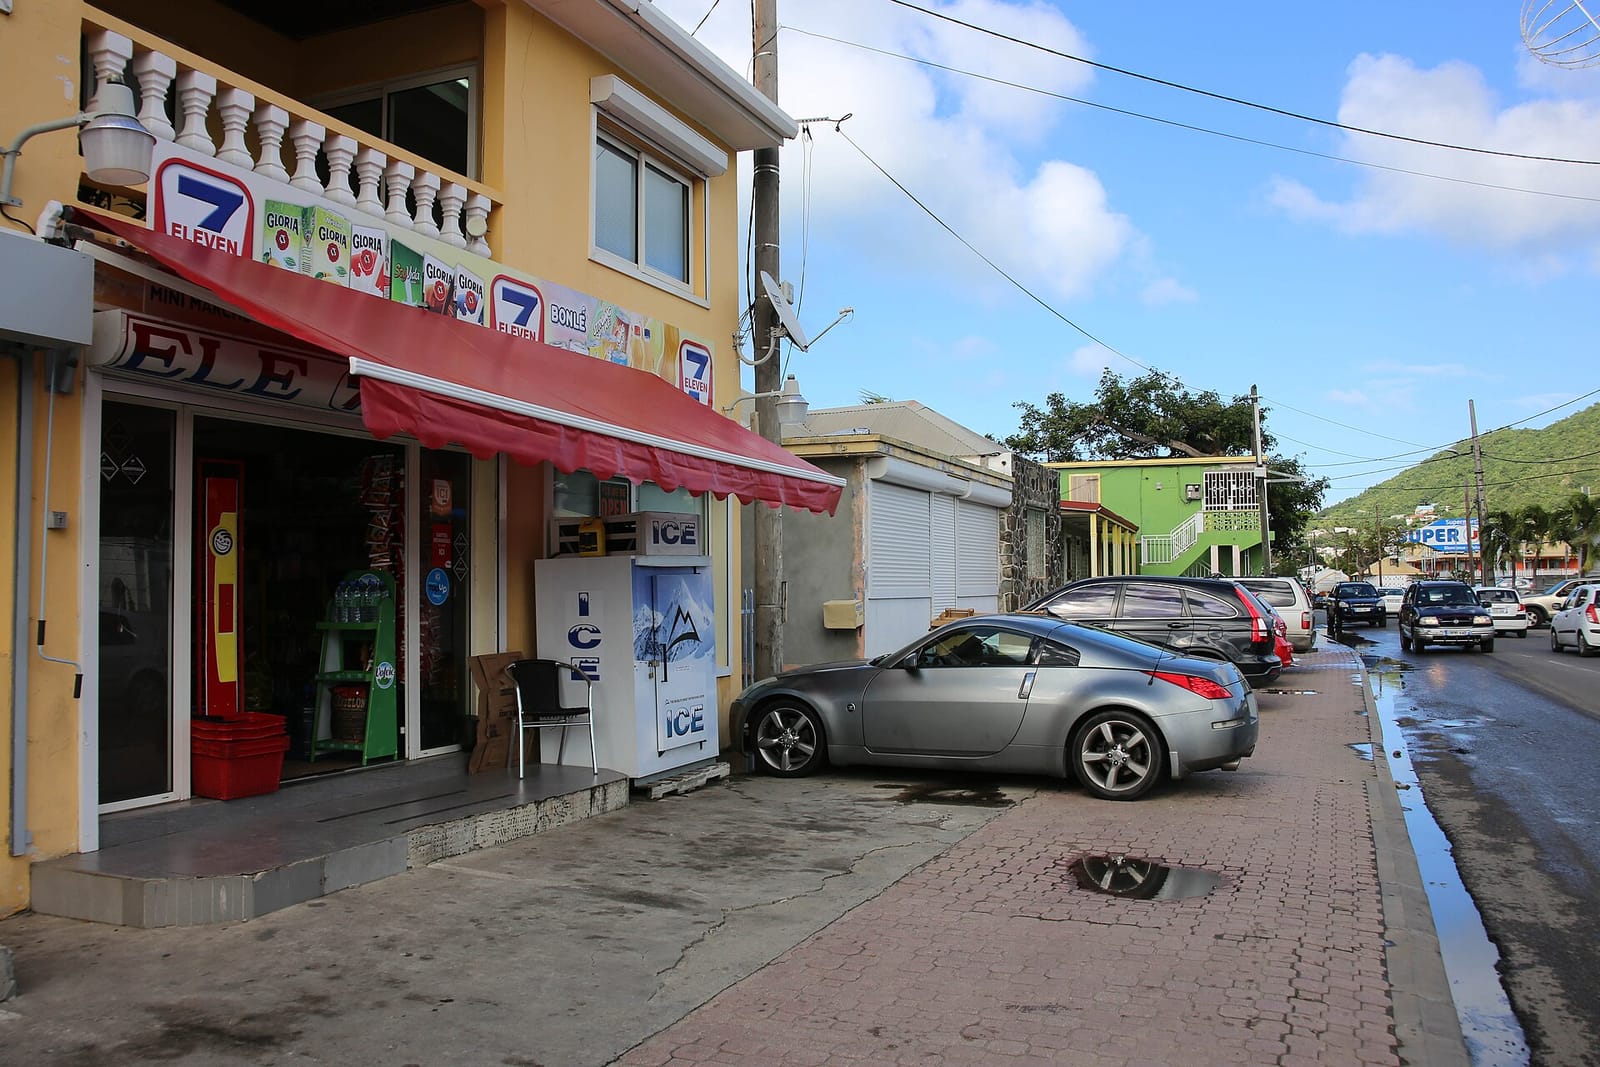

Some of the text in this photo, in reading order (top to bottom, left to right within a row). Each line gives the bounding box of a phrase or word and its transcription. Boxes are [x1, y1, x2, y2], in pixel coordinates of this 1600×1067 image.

[178, 174, 243, 233] 7
[267, 213, 298, 235] GLORIA
[171, 222, 238, 255] ELEVEN
[319, 227, 347, 249] GLORIA
[353, 234, 382, 256] GLORIA
[426, 263, 453, 286] GLORIA
[458, 274, 483, 299] GLORIA
[150, 283, 184, 307] MINI
[501, 286, 538, 327] 7
[550, 303, 587, 333] BONLÉ
[499, 321, 536, 341] ELEVEN
[685, 377, 708, 393] ELEVEN
[652, 520, 696, 545] ICE
[1399, 528, 1459, 542] SUPER
[568, 591, 601, 682] ICE
[666, 704, 704, 738] ICE
